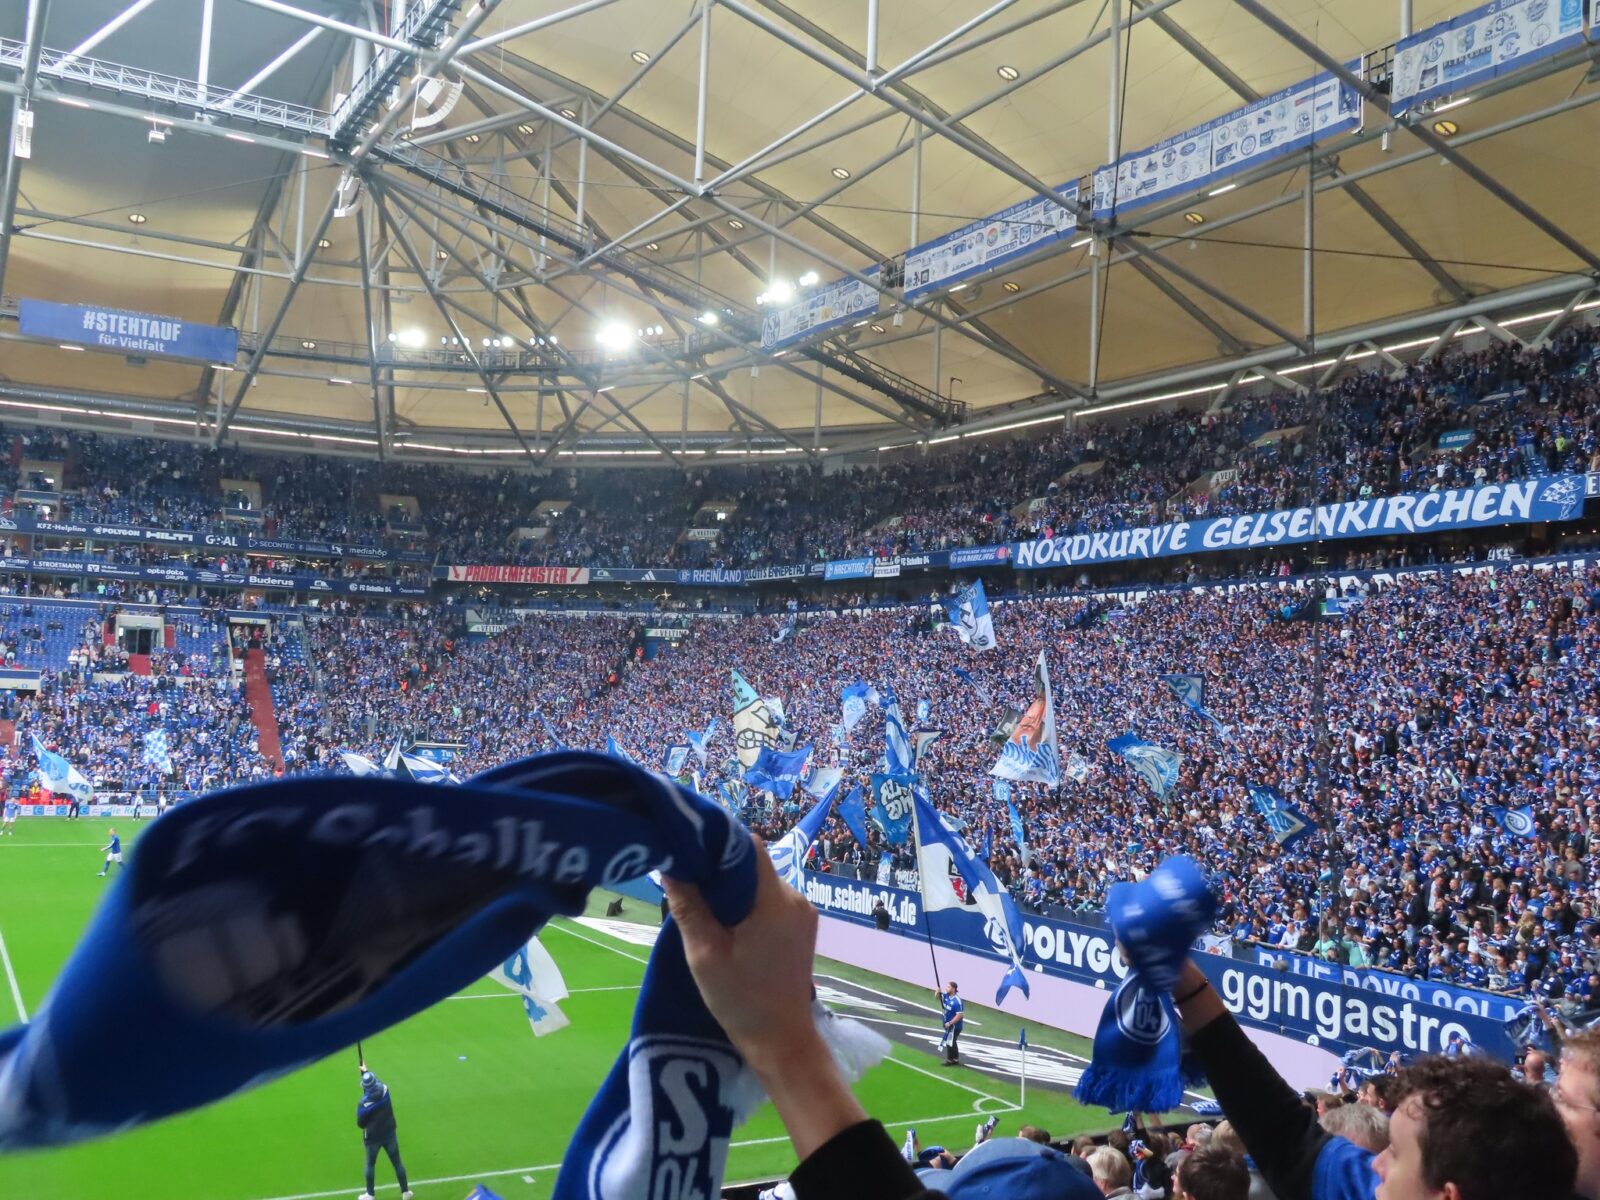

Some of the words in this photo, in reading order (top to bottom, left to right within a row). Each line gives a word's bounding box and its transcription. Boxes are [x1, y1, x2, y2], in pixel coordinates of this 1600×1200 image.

[83, 311, 182, 342] #STEHTAUF
[99, 333, 117, 347] für
[120, 336, 165, 353] Vielfalt
[36, 522, 87, 534] KFZ-Helpline
[102, 527, 140, 537] POLYGON
[1016, 522, 1191, 568] NORDKURVE
[1203, 480, 1537, 549] GELSENKIRCHEN
[146, 531, 194, 542] HILTI
[249, 575, 294, 586] Buderus
[464, 566, 568, 584] PROBLEMFENSTER
[693, 569, 742, 583] RHEINLAND
[1023, 922, 1130, 975] POLYGO
